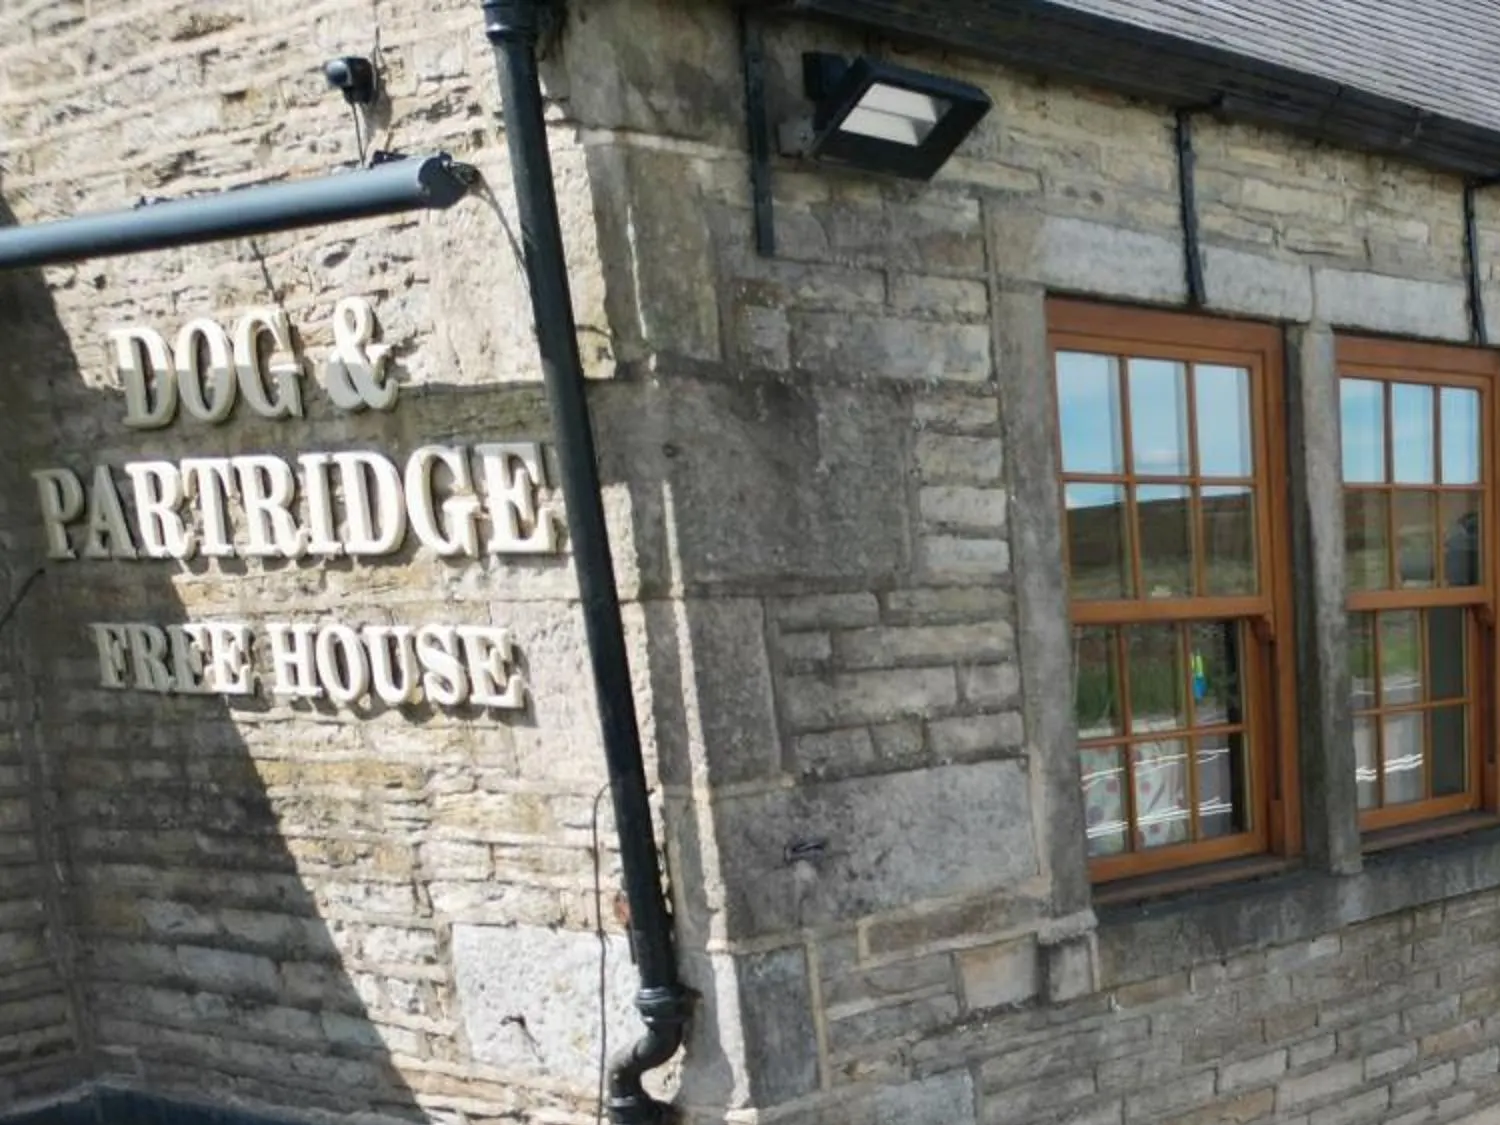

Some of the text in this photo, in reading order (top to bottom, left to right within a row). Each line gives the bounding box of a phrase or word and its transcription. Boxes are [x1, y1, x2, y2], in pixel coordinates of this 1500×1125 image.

[110, 297, 398, 429] DOG &
[32, 442, 565, 561] PARTRIDGE
[89, 620, 526, 709] FREE HOUSE
